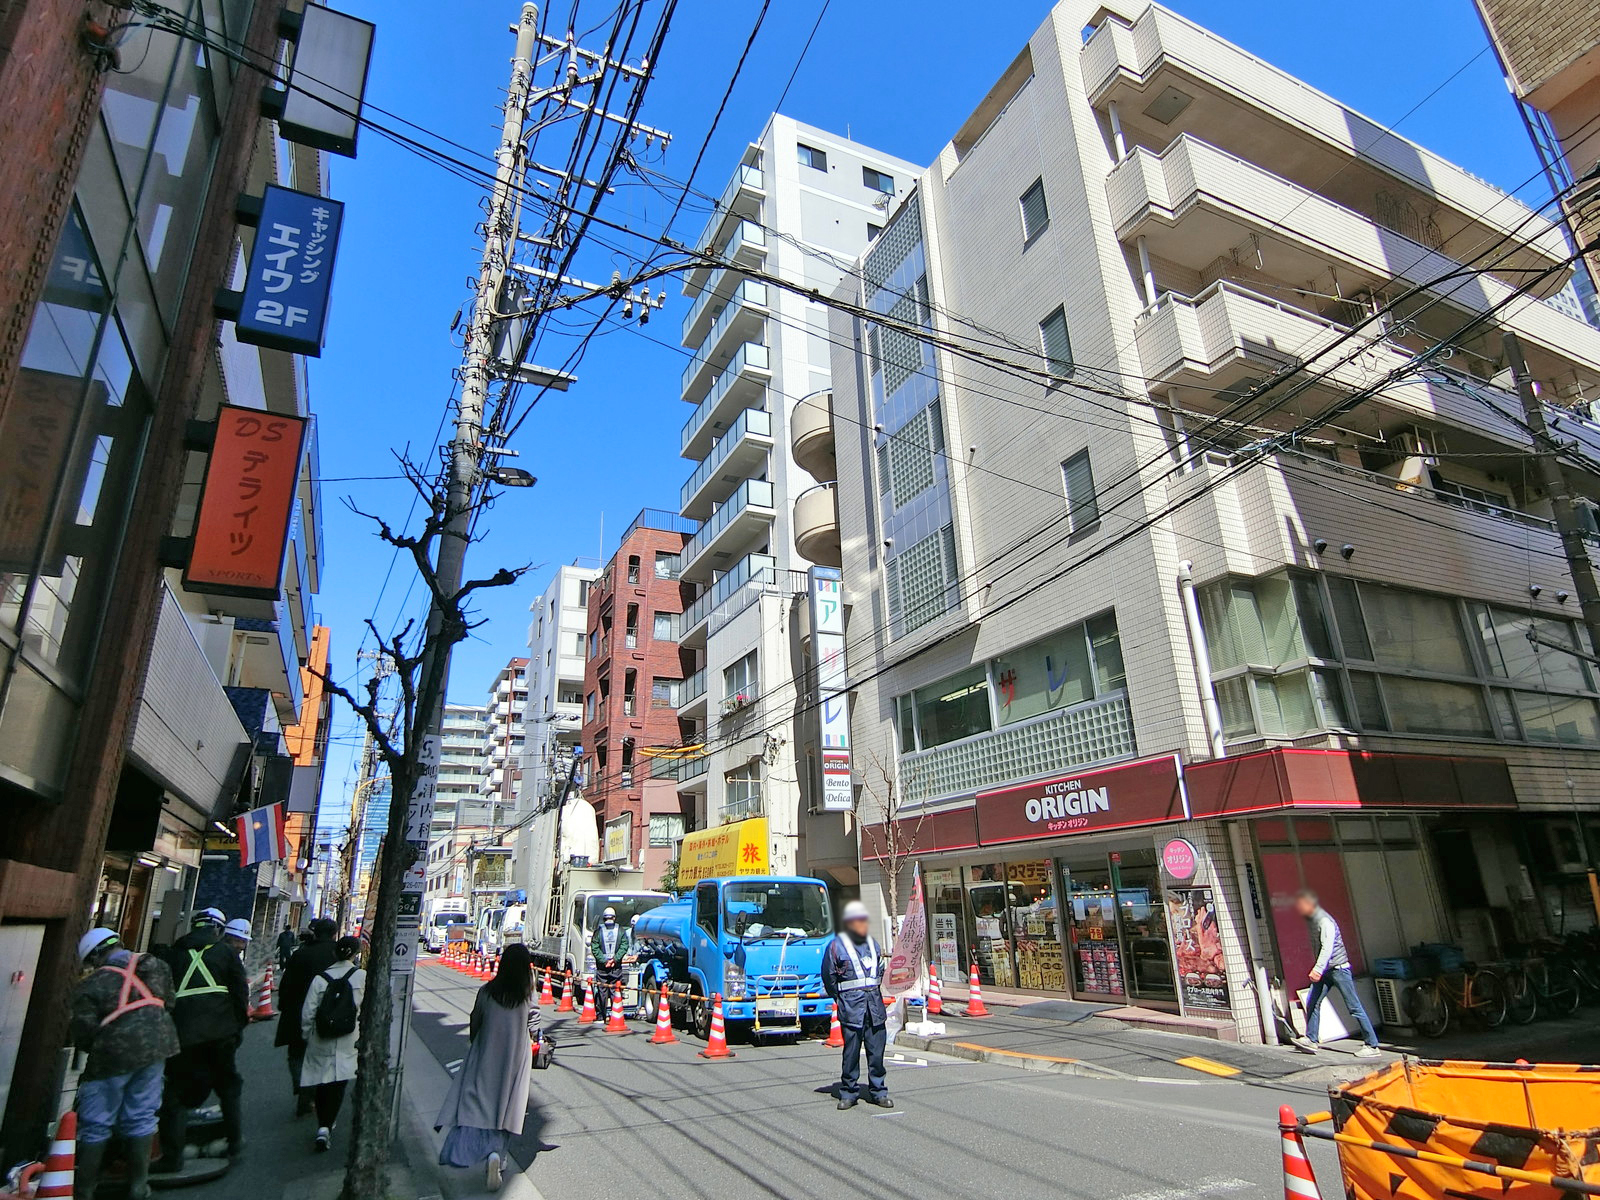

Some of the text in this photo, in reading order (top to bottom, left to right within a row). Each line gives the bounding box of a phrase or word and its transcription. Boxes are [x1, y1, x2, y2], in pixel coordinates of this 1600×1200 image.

[300, 206, 330, 284] キャッシング
[261, 222, 301, 294] エイワ
[254, 299, 309, 328] 2F
[235, 416, 288, 442] DS
[231, 450, 269, 556] デライツ
[823, 762, 850, 770] ORIGIN
[825, 777, 850, 788] Bento
[1045, 779, 1082, 795] KITCHEN
[825, 792, 851, 803] Delica
[1025, 786, 1110, 823] ORIGIN
[743, 843, 762, 864] 旅
[1166, 855, 1191, 865] オリジン
